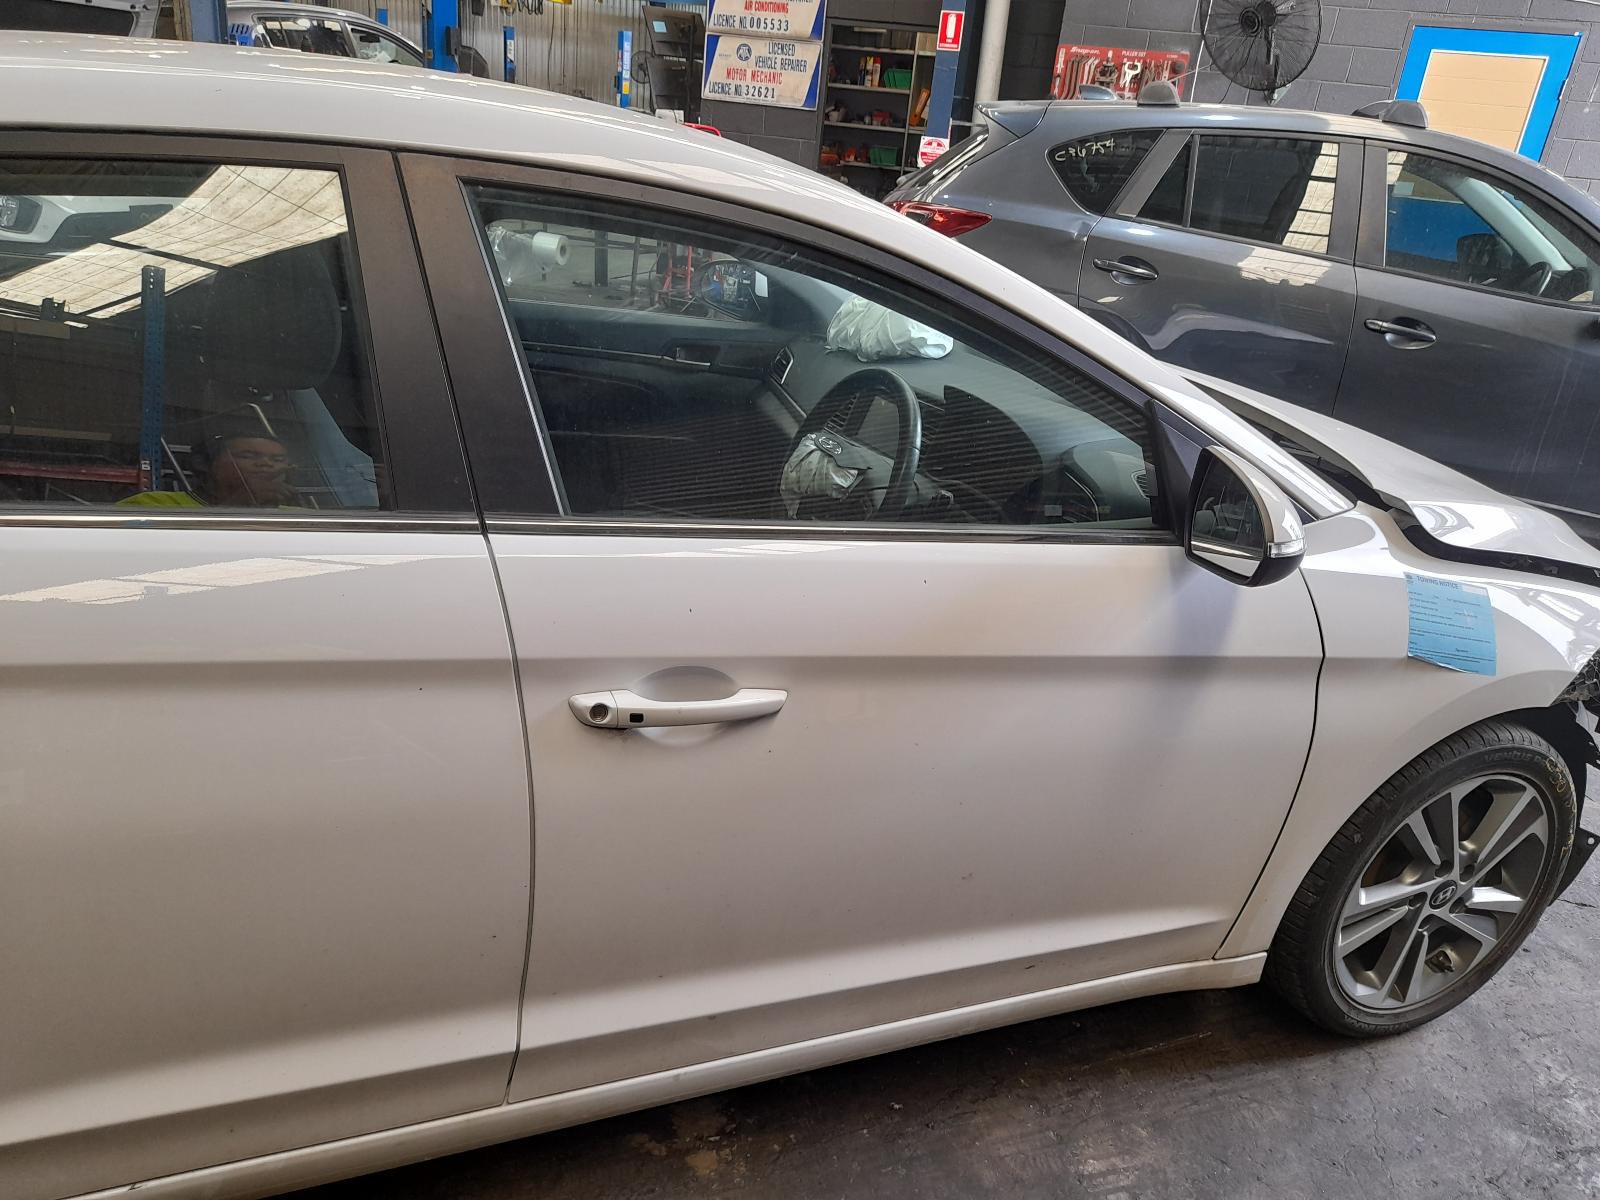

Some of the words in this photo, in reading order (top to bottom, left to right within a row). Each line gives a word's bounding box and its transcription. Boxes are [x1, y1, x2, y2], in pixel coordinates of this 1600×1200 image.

[744, 0, 753, 11] AIR
[754, 1, 789, 14] CONDITIONING
[713, 14, 736, 28] LICENCE
[749, 16, 789, 31] 005533
[768, 41, 796, 56] LICENSED
[755, 55, 777, 69] VEHICLE
[780, 57, 807, 72] REPAIRER
[726, 67, 747, 82] MOTOR
[751, 69, 783, 85] MECHANIC
[709, 82, 731, 95] LICENCE
[745, 85, 775, 98] 32621
